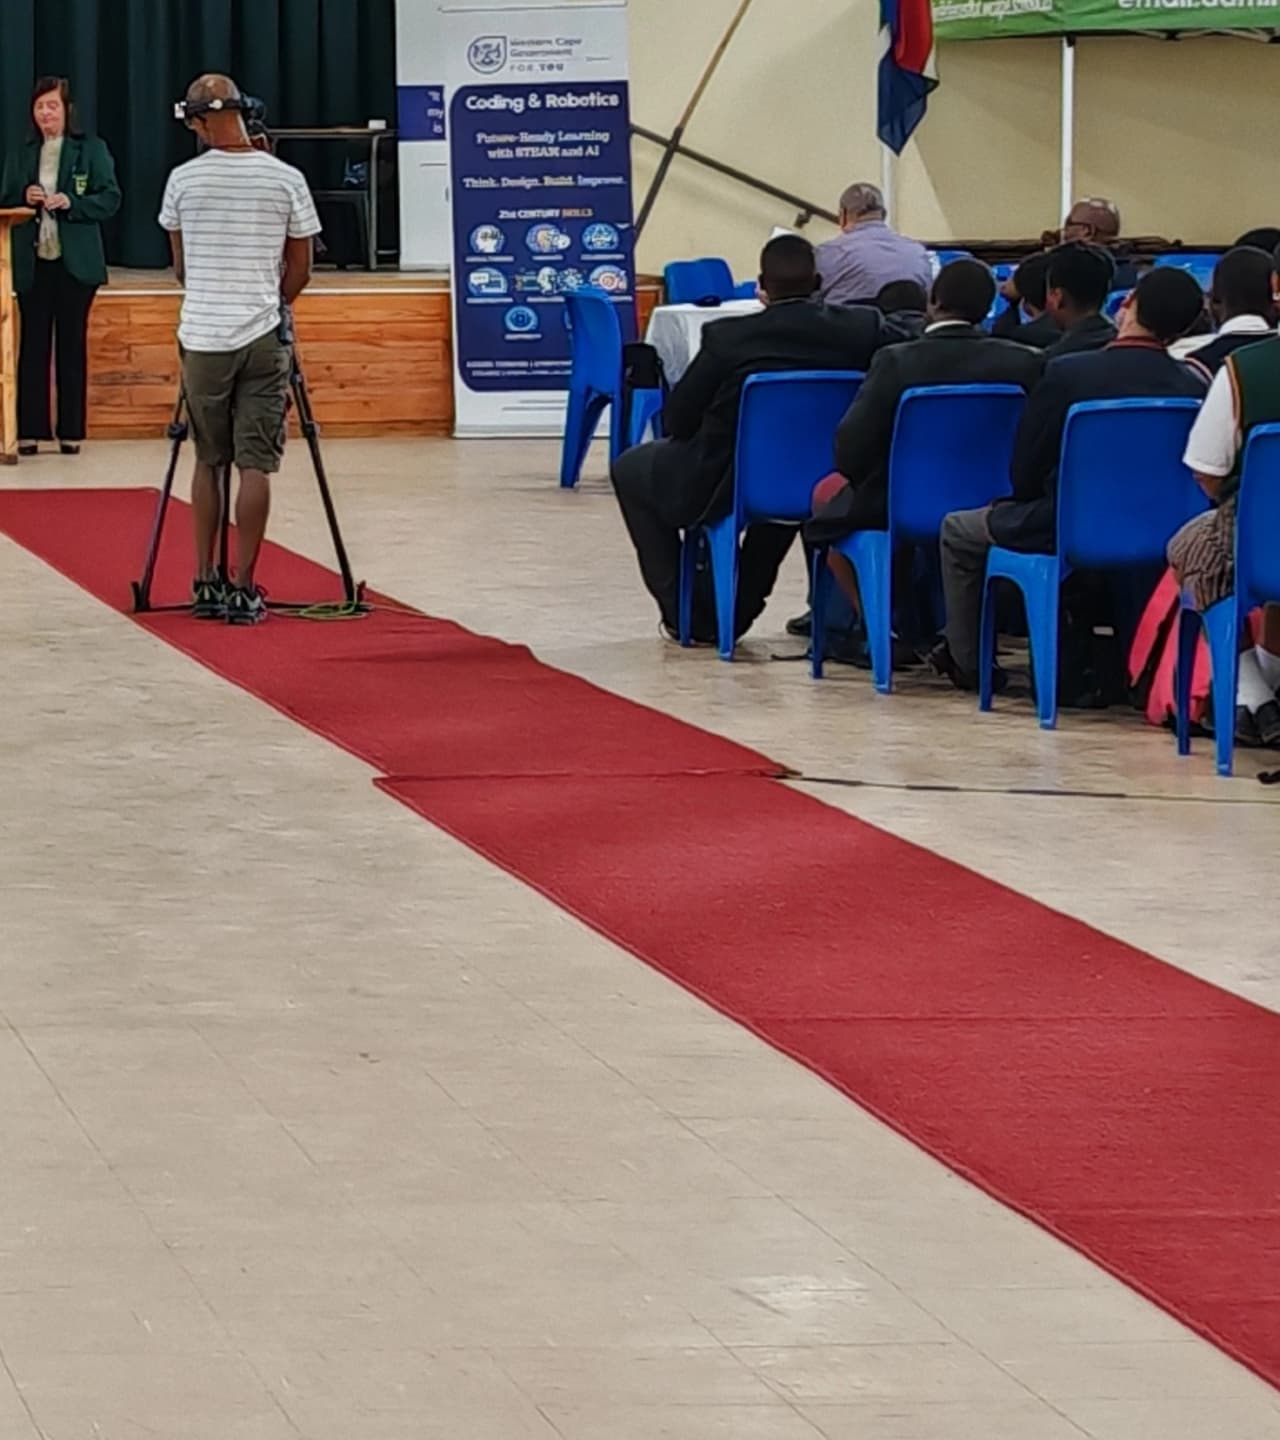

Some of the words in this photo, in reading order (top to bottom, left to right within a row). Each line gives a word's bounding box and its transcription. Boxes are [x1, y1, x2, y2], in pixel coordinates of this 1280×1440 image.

[465, 94, 525, 113] Coding
[528, 93, 541, 108] &
[545, 92, 619, 108] Robotics
[476, 131, 556, 144] Future-Ready
[558, 130, 610, 143] Learning
[488, 147, 513, 159] with
[515, 146, 559, 158] STEAM
[561, 146, 582, 157] and
